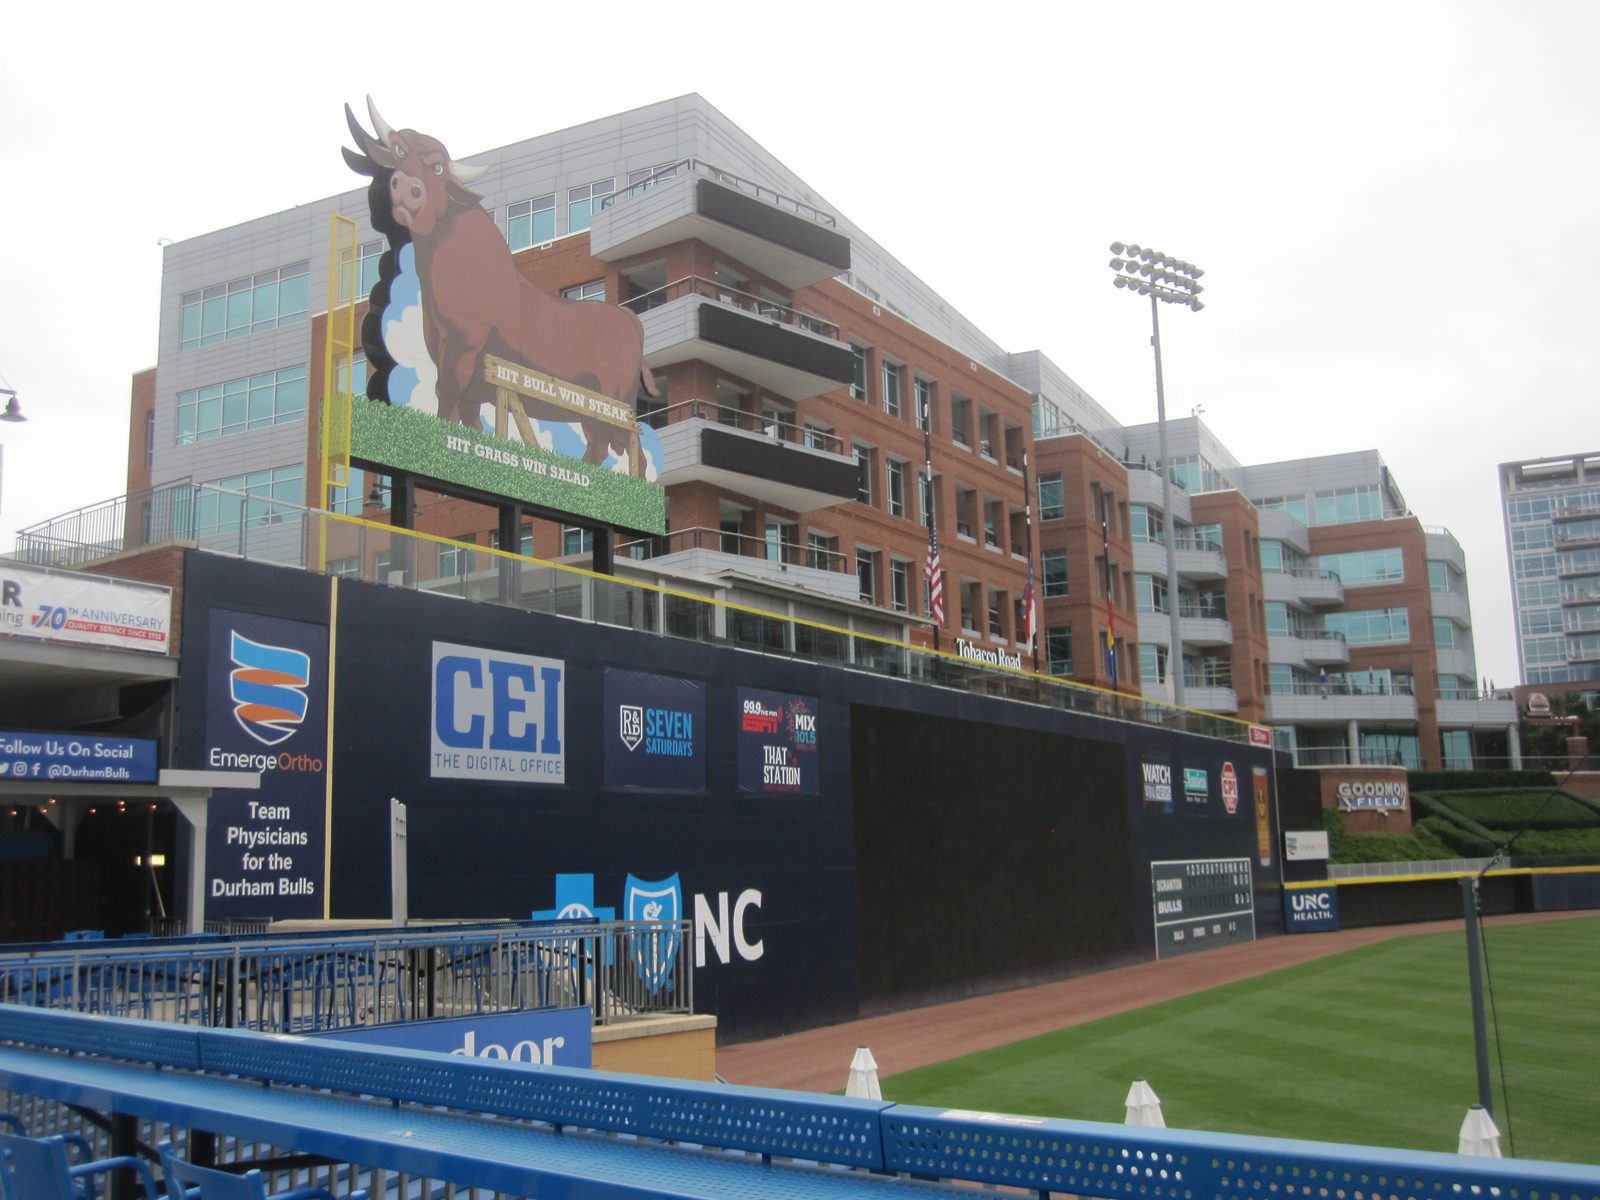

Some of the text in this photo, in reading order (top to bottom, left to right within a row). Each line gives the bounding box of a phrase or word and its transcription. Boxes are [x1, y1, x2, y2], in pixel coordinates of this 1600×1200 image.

[497, 365, 628, 422] HIT BULL WIN STEAK
[446, 435, 590, 487] HIT GRASS WIN SALAD
[0, 608, 24, 628] ing
[81, 609, 165, 629] ANNIVERSARY
[67, 622, 98, 630] QUALITY
[99, 625, 127, 635] SERVICE
[128, 629, 149, 638] SINCE
[956, 637, 1022, 671] Tobacco Road
[435, 655, 561, 755] CEI
[743, 700, 762, 714] 99.9
[623, 709, 641, 736] R&D
[645, 708, 692, 740] SEVEN
[795, 714, 816, 731] MIX
[645, 737, 693, 757] SATURDAYS
[796, 730, 817, 744] 101.5
[0, 738, 134, 759] Follow Us On Social
[763, 745, 788, 765] THAT
[210, 747, 323, 773] EmergeOrtho
[435, 753, 562, 775] THE DIGITAL OFFICE
[48, 764, 130, 779] @DurhamBulls
[763, 765, 801, 785] STATION
[1142, 763, 1171, 784] WATCH
[249, 801, 290, 820] Team
[1357, 797, 1399, 807] FIELD
[227, 826, 308, 849] Physicians
[243, 852, 293, 870] for the
[212, 877, 315, 897] Durham Bulls
[1158, 899, 1183, 914] BULLS
[1291, 893, 1330, 911] UNC
[1293, 911, 1331, 921] HEALTH
[694, 888, 765, 968] NC
